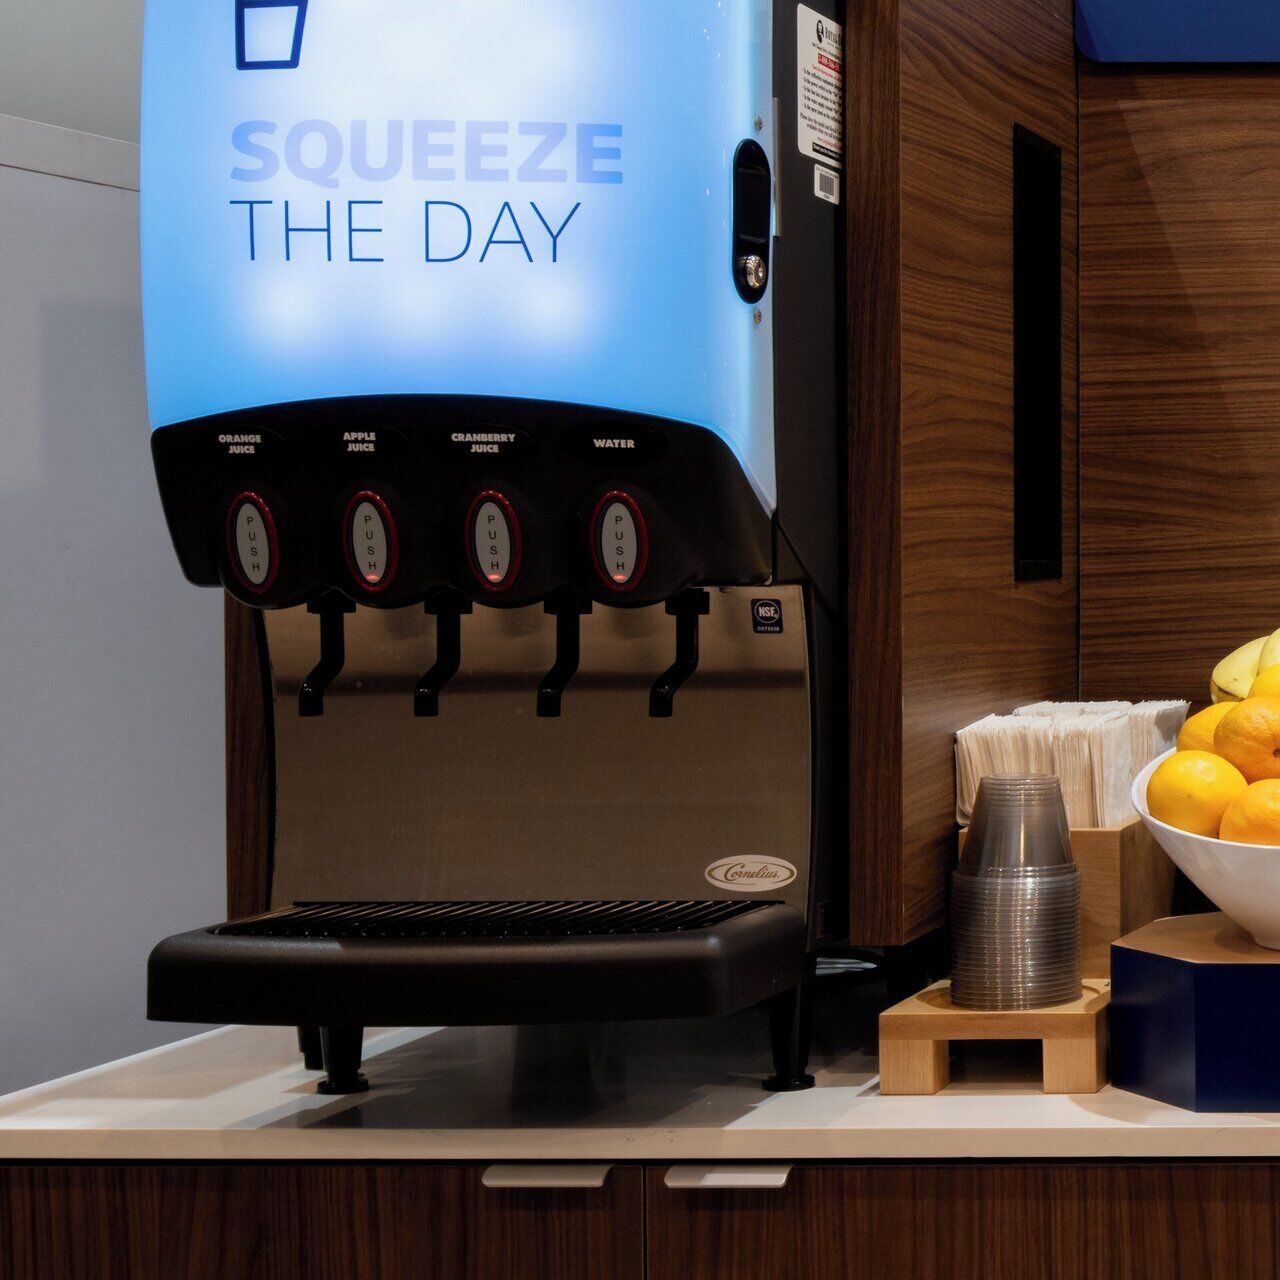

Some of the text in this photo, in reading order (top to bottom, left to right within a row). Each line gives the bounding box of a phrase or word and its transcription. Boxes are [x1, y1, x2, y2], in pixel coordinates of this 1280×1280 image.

[229, 119, 623, 188] SQUEEZE
[229, 199, 582, 264] THE DAY
[218, 434, 261, 443] ORANGE
[343, 432, 376, 441] APPLE
[451, 433, 516, 442] CRANBERRY
[593, 439, 635, 448] WATER
[228, 445, 255, 454] JUICE
[347, 443, 375, 452] JUICE
[470, 444, 499, 453] JUICE
[246, 516, 260, 571] PUSH
[364, 515, 377, 570] PUSH
[487, 515, 499, 570] PUSH
[615, 516, 625, 570] PUSH
[724, 862, 779, 881] Cornelius
